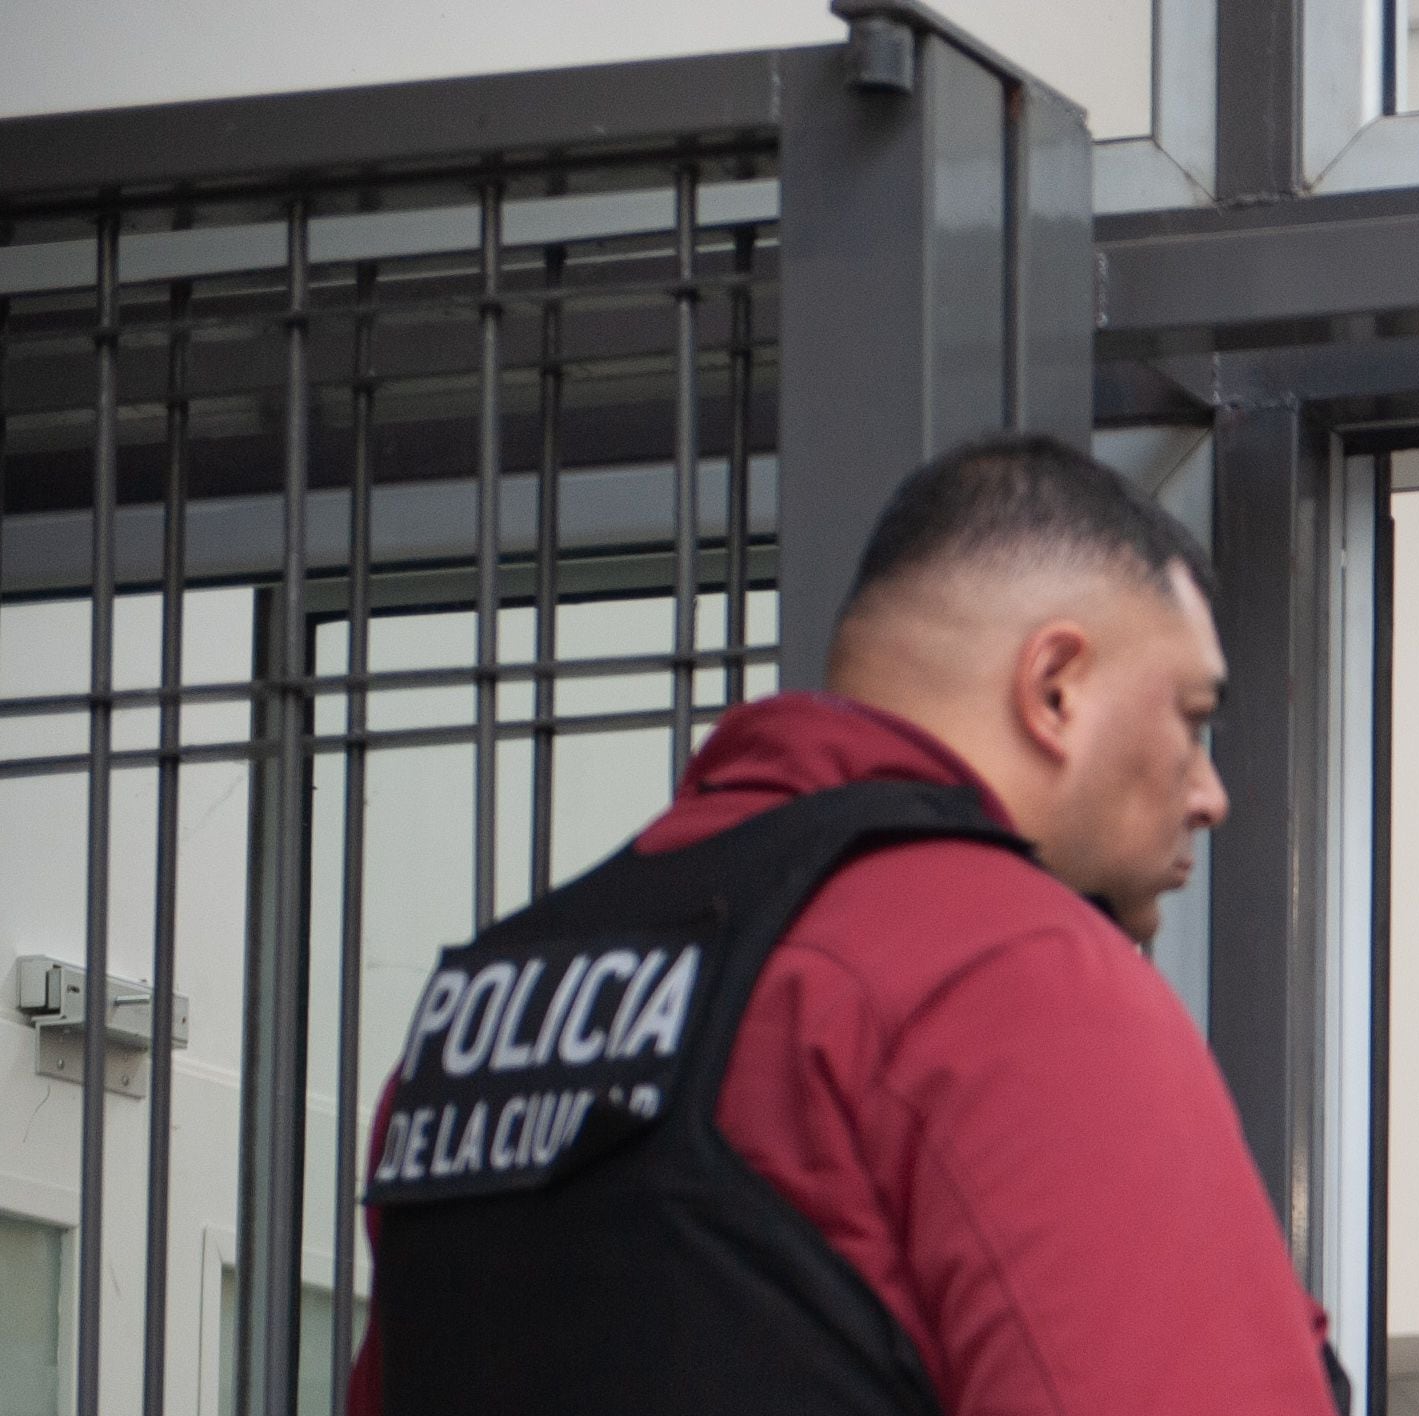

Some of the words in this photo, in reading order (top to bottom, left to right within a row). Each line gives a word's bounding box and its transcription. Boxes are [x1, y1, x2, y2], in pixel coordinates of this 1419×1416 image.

[400, 945, 700, 1082] POLICIA
[374, 1106, 436, 1183] DE
[430, 1101, 489, 1177] LA
